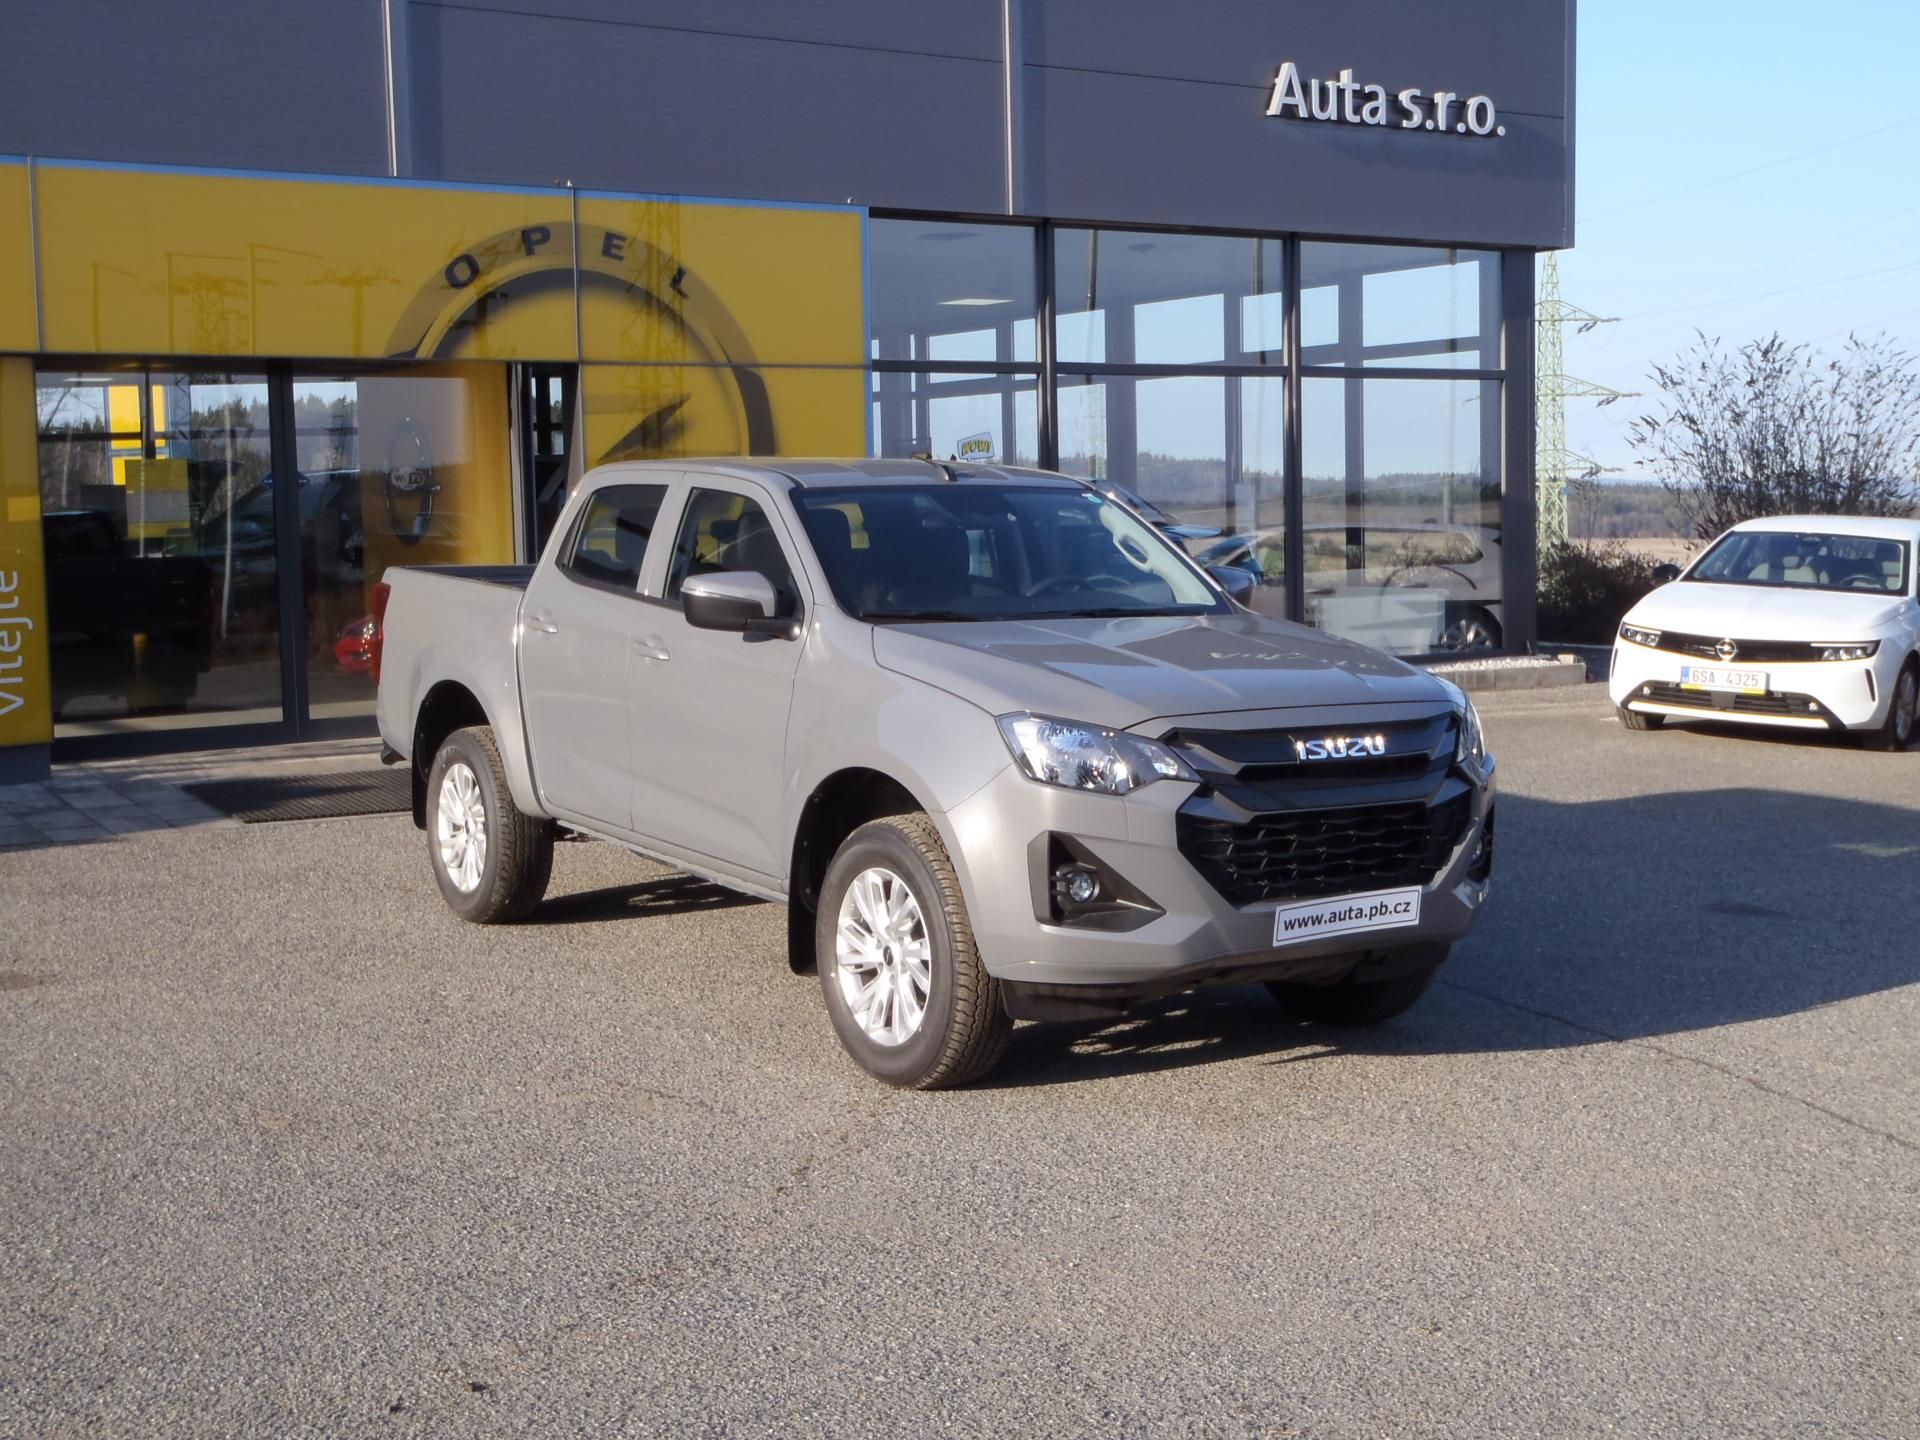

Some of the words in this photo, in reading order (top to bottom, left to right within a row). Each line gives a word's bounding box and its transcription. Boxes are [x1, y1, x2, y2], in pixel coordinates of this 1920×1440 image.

[1266, 62, 1387, 125] Auta
[1399, 89, 1506, 136] s.r.o.
[445, 226, 690, 299] OPEL
[1692, 670, 1715, 684] 6SA
[1726, 672, 1759, 688] 4325
[1296, 735, 1385, 760] ISUZU
[1284, 901, 1411, 931] www.auta.pb.cz
